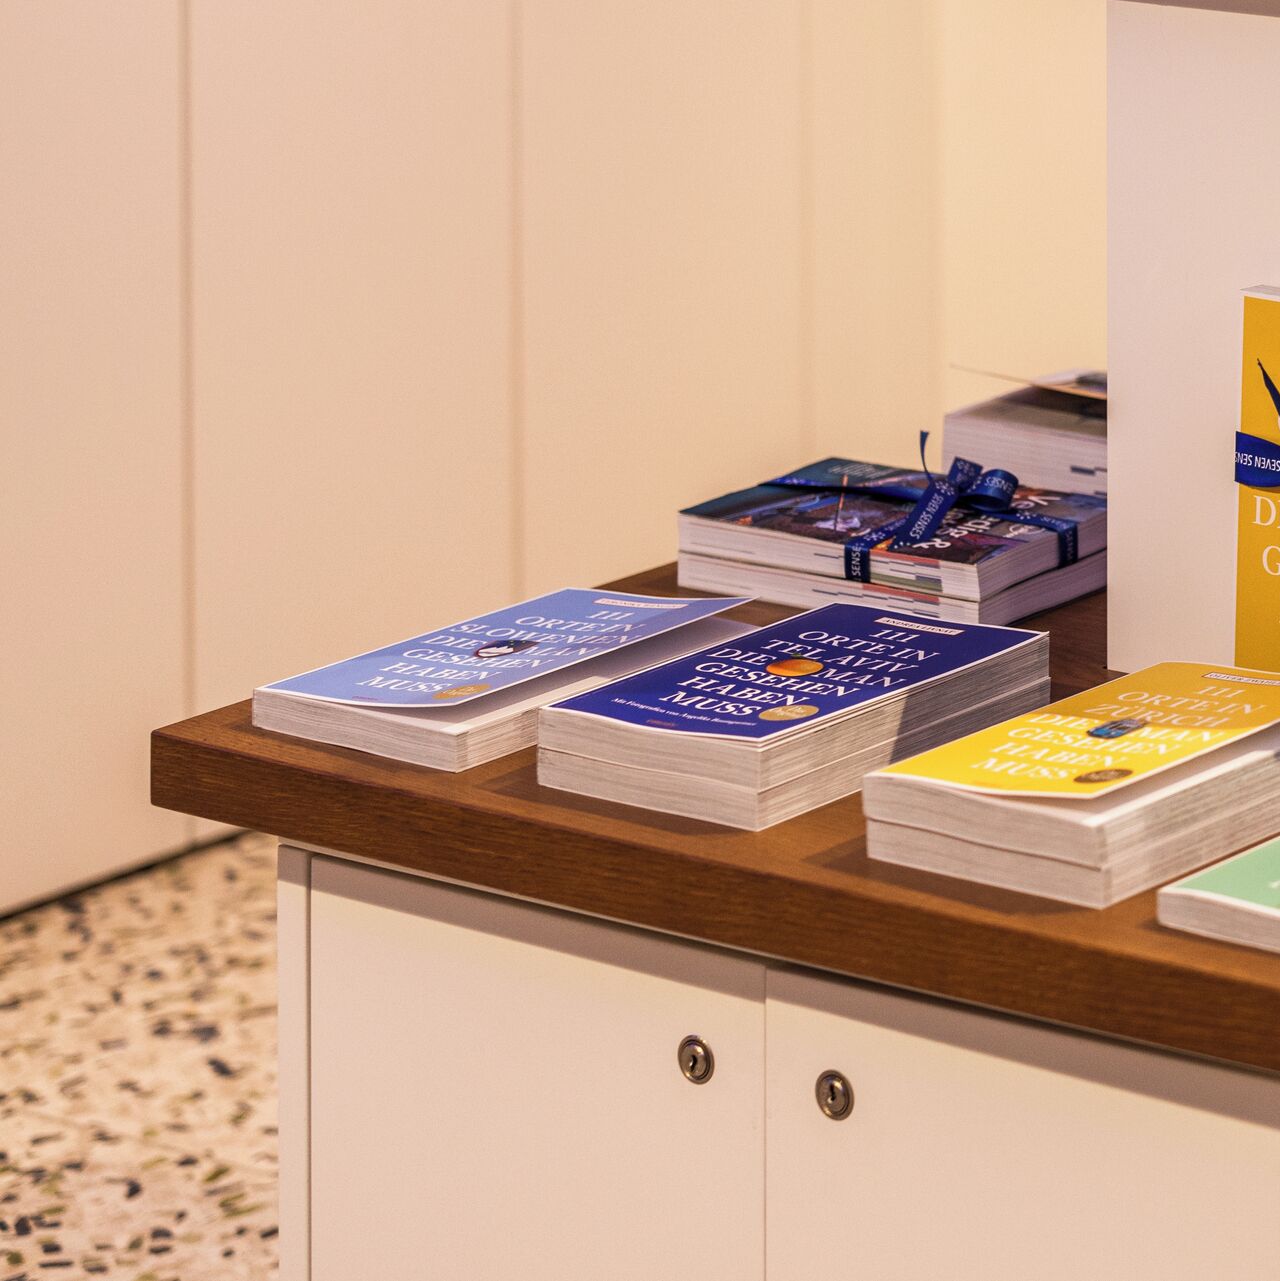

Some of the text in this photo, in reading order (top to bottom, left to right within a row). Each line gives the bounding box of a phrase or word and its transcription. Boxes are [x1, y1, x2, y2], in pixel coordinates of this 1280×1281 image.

[1255, 456, 1280, 472] SEVEN
[910, 492, 944, 539] SEVEN SENSES
[851, 543, 862, 576] SENSE
[515, 616, 643, 634] ORTE IN
[586, 610, 634, 621] 111
[423, 634, 599, 657] DIE MAN
[798, 630, 940, 661] ORTE IN
[868, 629, 920, 643] 111
[402, 647, 553, 669] GESEHEN
[706, 648, 908, 688] DIE MAN
[761, 639, 921, 675] TEL AVIV
[380, 662, 501, 680] HABEN
[695, 662, 860, 699] GESEHEN
[356, 675, 453, 693] MUSS
[677, 676, 811, 705] HABEN
[1197, 685, 1247, 699] 111
[659, 690, 764, 716] MUSS
[1117, 691, 1266, 715] ORTE IN
[1026, 712, 1226, 742] DIE MAN
[1008, 727, 1181, 756] GESEHEN
[990, 741, 1130, 768] HABEN
[970, 756, 1078, 780] MUSS
